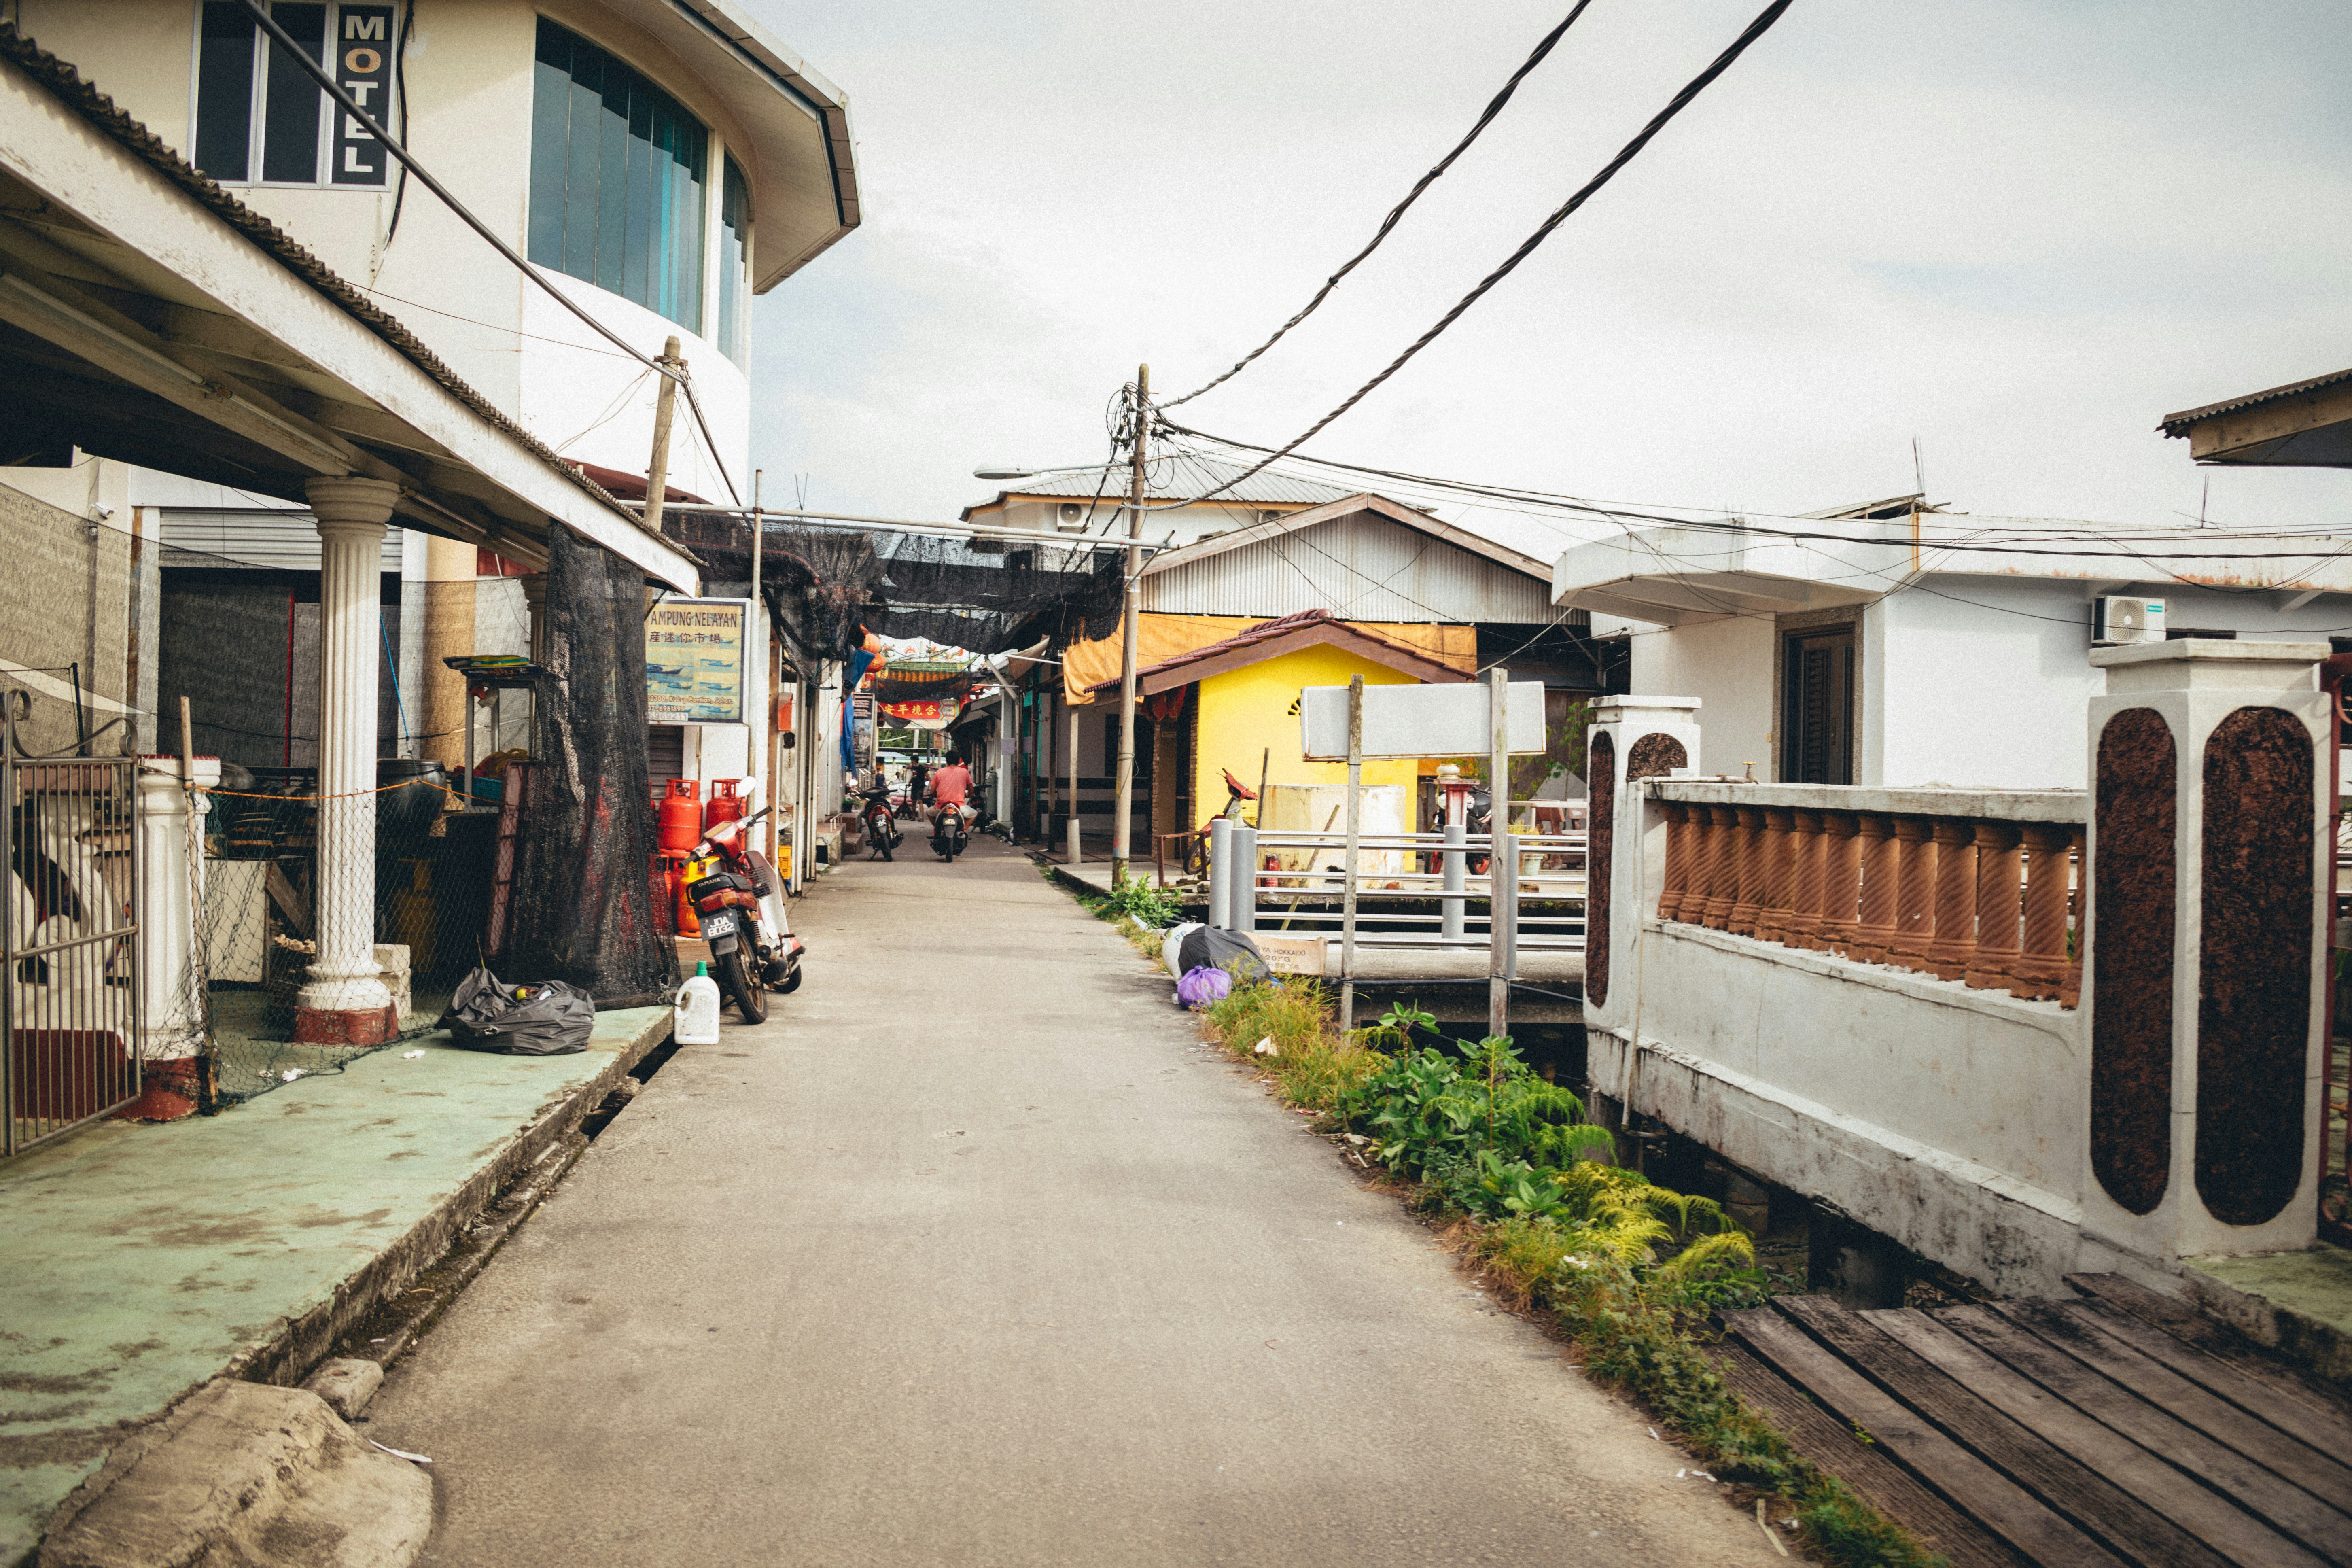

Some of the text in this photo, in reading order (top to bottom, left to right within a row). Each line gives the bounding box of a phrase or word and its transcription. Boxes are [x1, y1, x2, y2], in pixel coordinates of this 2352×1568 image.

[345, 15, 385, 173] MOTEL
[694, 612, 737, 627] NELAYAN
[669, 696, 688, 704] Kukup
[698, 878, 721, 887] YAMAHA
[710, 916, 730, 928] JDA
[707, 923, 735, 937] 8032
